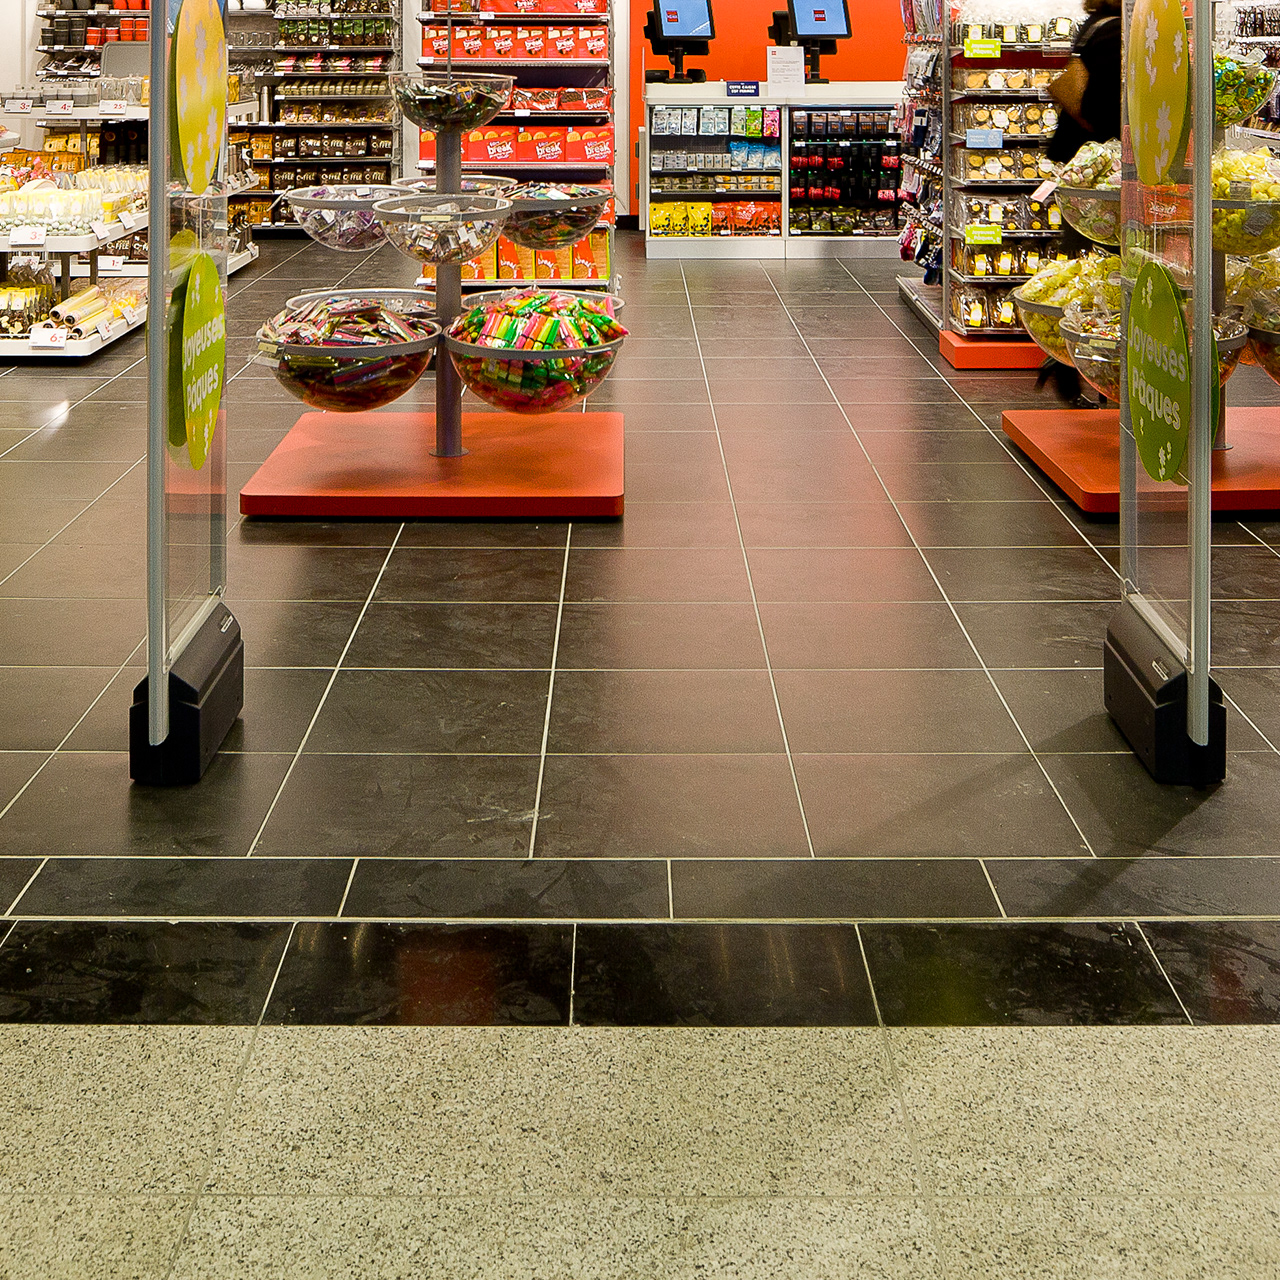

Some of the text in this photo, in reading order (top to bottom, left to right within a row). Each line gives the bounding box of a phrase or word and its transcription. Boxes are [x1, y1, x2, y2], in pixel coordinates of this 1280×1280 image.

[183, 313, 223, 371] Joyeuses
[1129, 316, 1186, 382] Joyeuses
[187, 363, 219, 419] Pâques
[1133, 366, 1180, 430] Pâques
